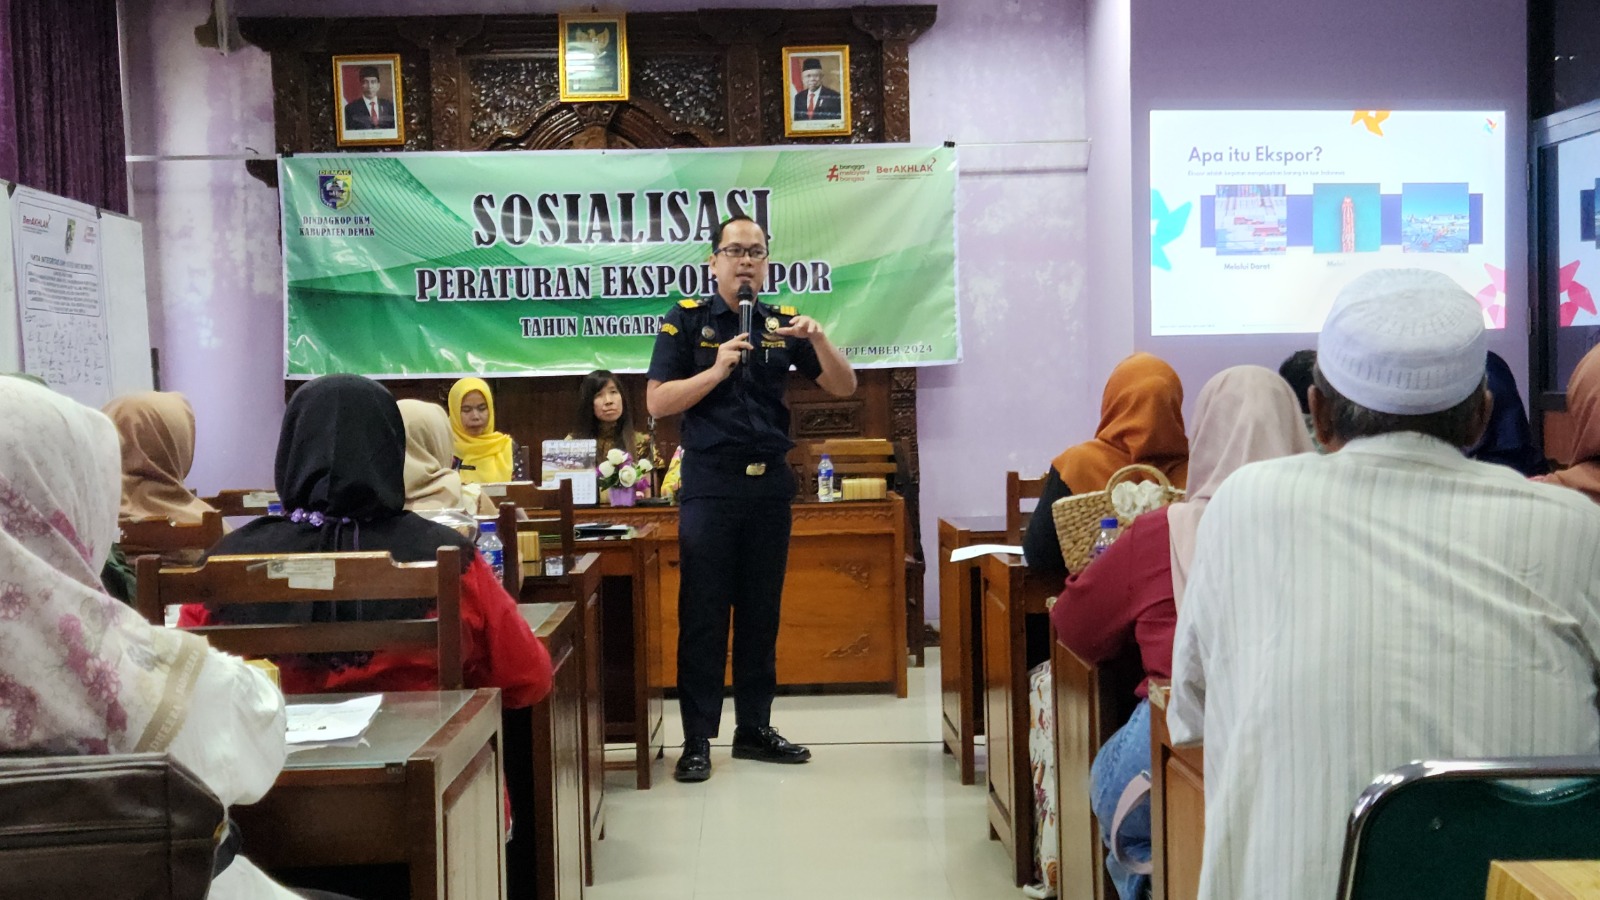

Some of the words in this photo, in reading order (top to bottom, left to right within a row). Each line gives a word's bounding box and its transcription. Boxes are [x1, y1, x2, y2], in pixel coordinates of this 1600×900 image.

[1188, 147, 1223, 166] Apa
[1229, 146, 1250, 161] itu
[1256, 145, 1323, 166] Ekspor?
[876, 160, 935, 174] BerAKHLAK
[354, 216, 370, 224] UKM
[299, 228, 346, 236] KABUPATEN
[348, 227, 375, 236] DEMAK
[416, 266, 589, 300] PERATURAN
[603, 264, 718, 296] EKSPOR
[761, 262, 830, 292] POR
[521, 317, 576, 337] TAHUN
[838, 346, 900, 356] EPTEMBER
[904, 345, 933, 353] 2024
